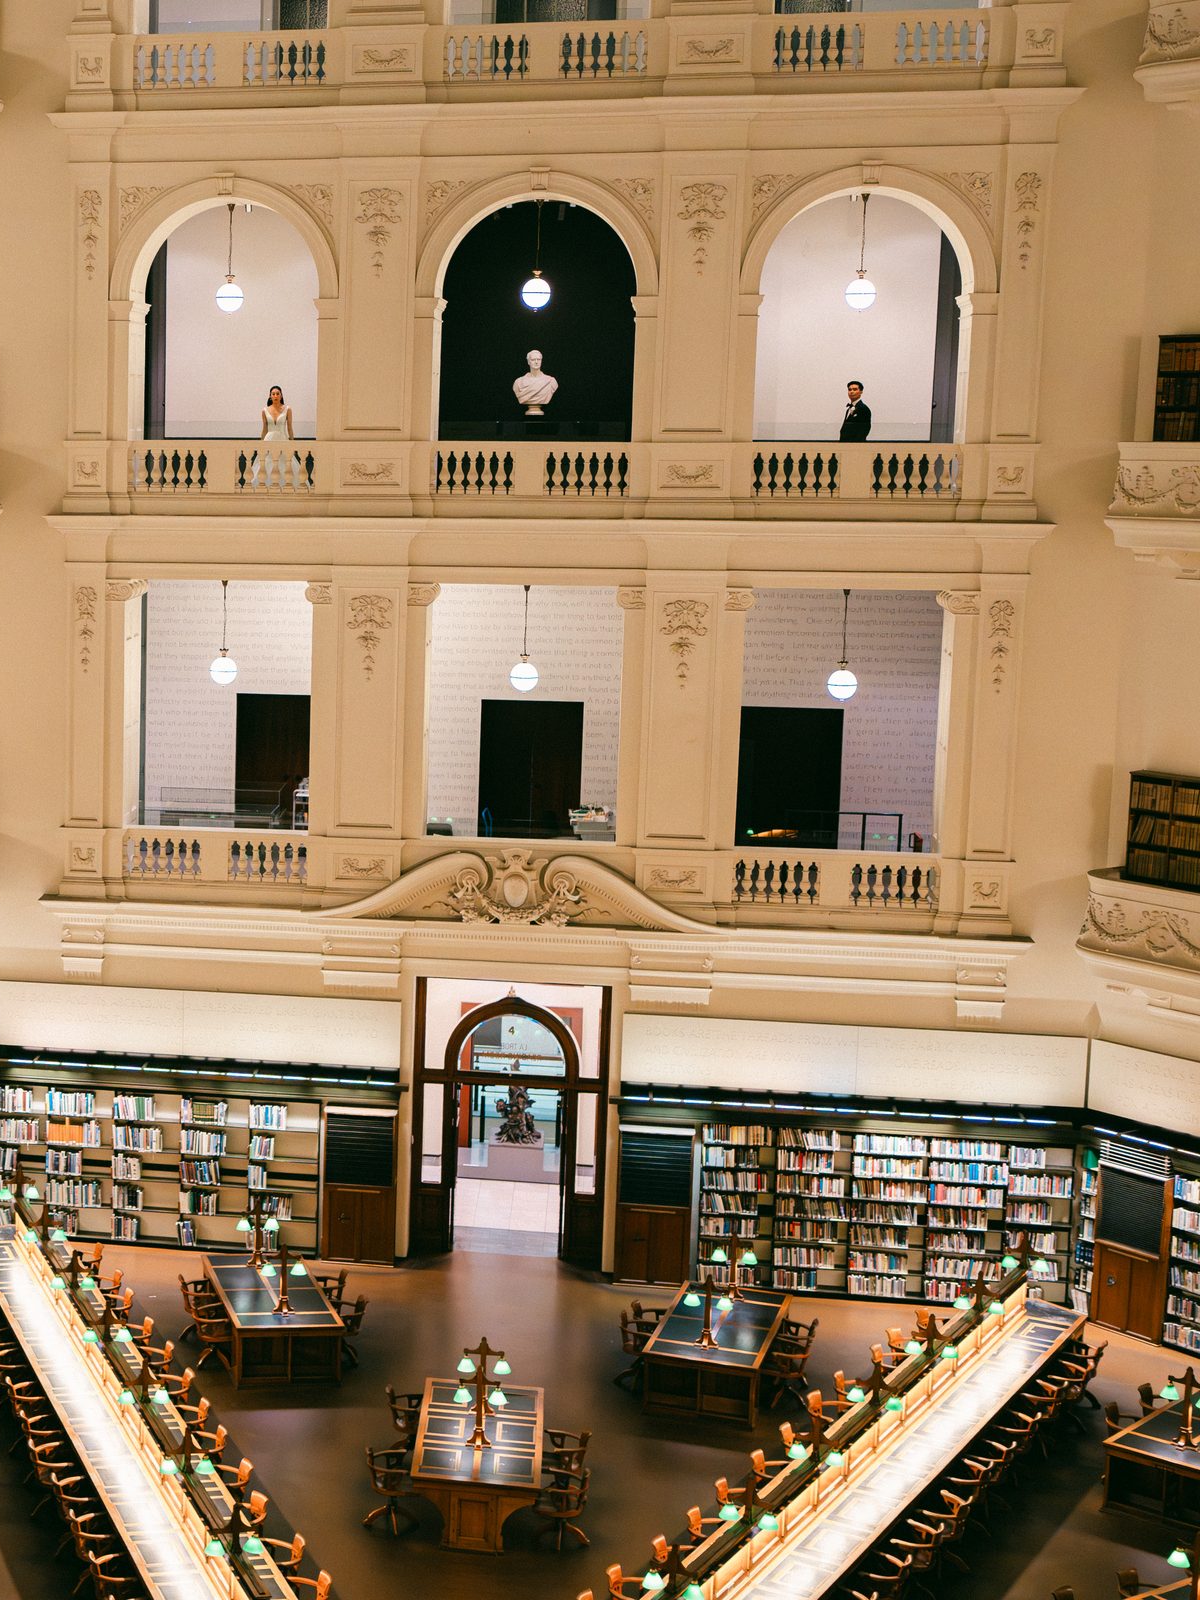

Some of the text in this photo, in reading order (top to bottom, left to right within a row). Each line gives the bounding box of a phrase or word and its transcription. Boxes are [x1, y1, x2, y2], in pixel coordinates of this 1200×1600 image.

[508, 1026, 515, 1035] 4
[645, 1025, 685, 1038] BOOKS
[690, 1027, 711, 1039] ARE
